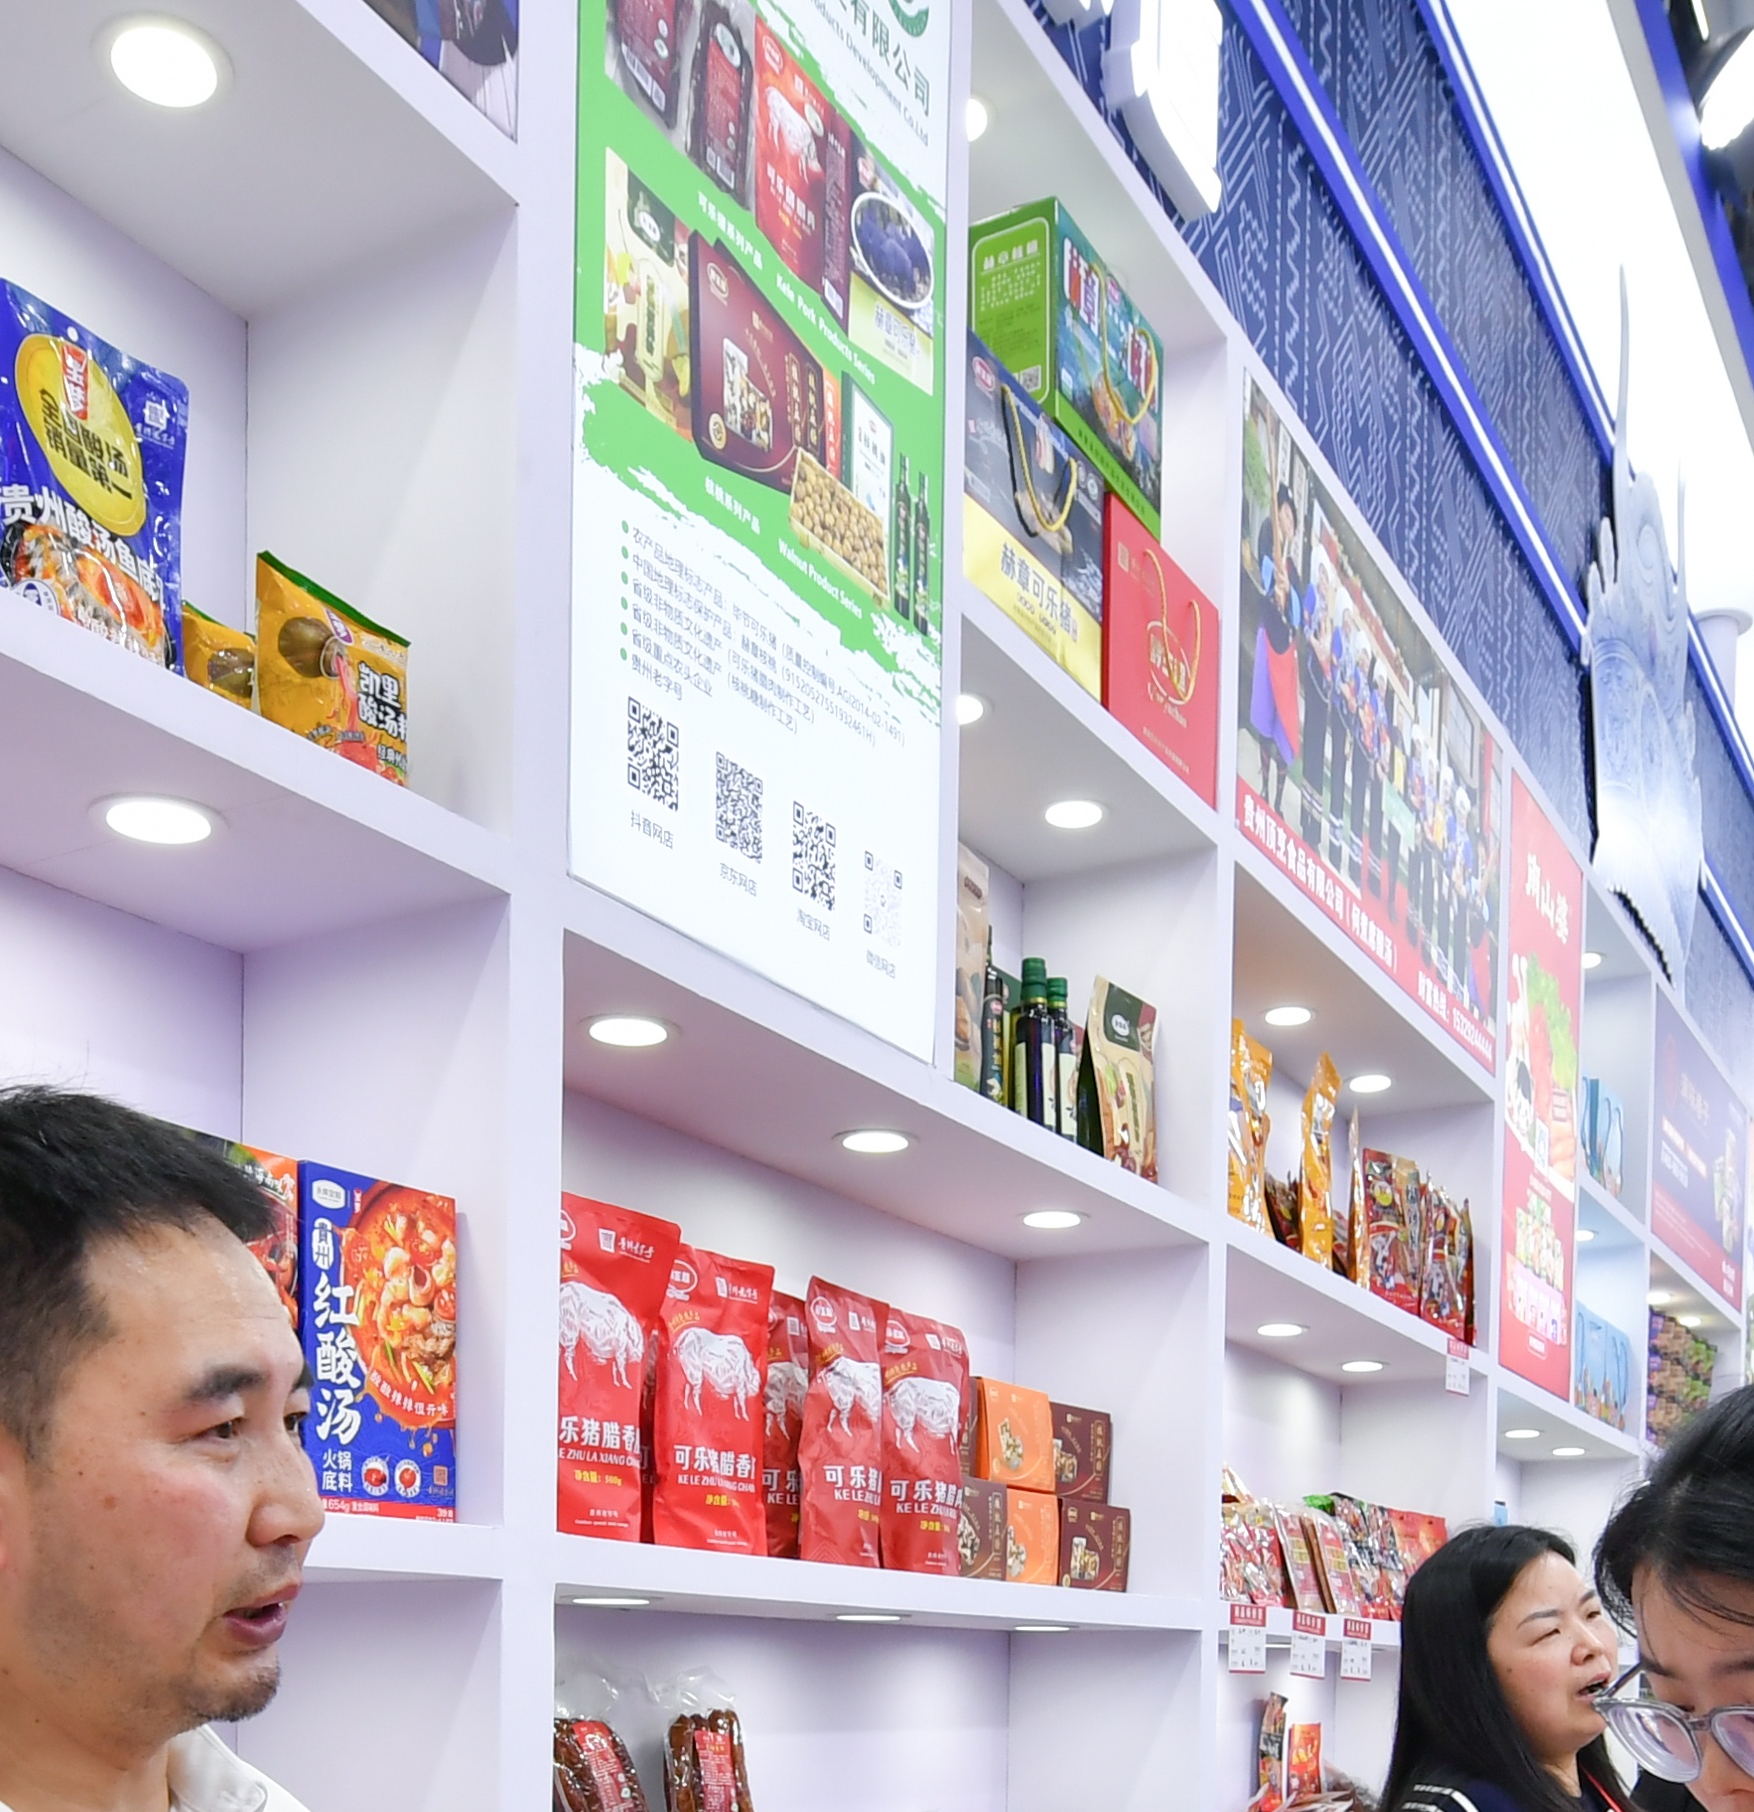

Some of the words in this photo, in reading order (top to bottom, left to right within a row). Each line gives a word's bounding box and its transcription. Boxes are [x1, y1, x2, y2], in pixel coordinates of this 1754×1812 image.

[41, 388, 128, 477] 全国酸汤
[45, 427, 133, 500] 销量第一
[1000, 543, 1074, 638] 赫章可乐猪
[630, 810, 674, 849] 抖音网店
[719, 863, 757, 897] 京东网店
[314, 1271, 361, 1445] 红酸汤
[322, 1448, 352, 1471] 火锅
[322, 1470, 352, 1493] 底料
[823, 1465, 882, 1494] 可乐猪
